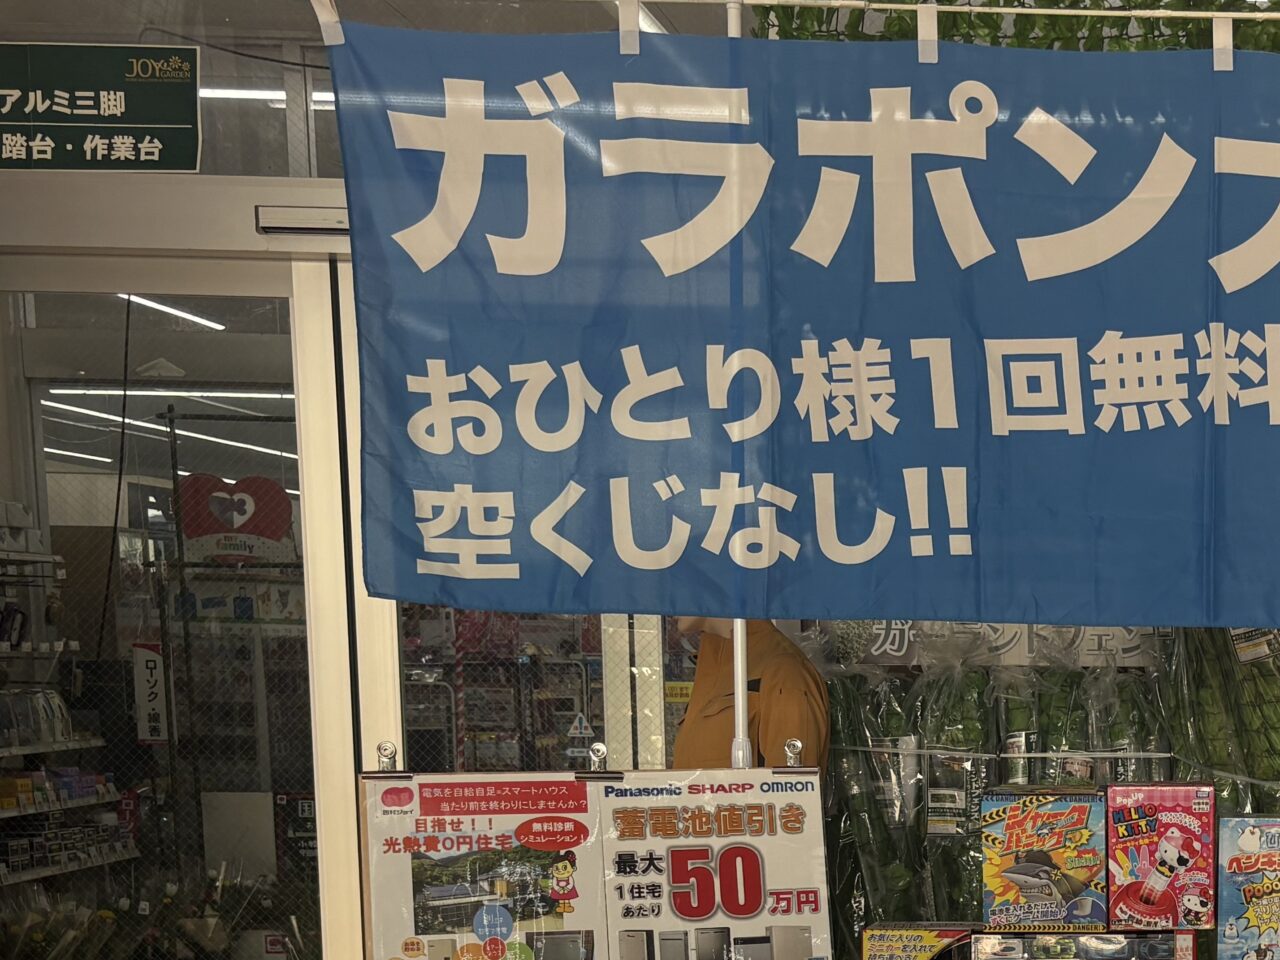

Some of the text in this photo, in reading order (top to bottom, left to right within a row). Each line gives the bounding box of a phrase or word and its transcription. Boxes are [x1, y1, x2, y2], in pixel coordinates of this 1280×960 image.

[0, 89, 126, 117] アルミ三脚
[2, 133, 163, 162] 踏台・作業台
[414, 467, 972, 579] 空くじなし!!
[604, 781, 815, 797] Panasonic SHARP OMRON
[614, 804, 806, 840] 蓄電池値引き
[1004, 804, 1090, 833] シャーク
[1112, 804, 1157, 824] HELLO
[532, 822, 575, 832] 無料診断
[1117, 819, 1157, 839] KITTY
[615, 852, 665, 876] 最大
[669, 844, 763, 919] 50
[623, 905, 662, 918] あたり
[768, 889, 820, 914] 万円
[868, 944, 936, 953] ミニカーを入れて
